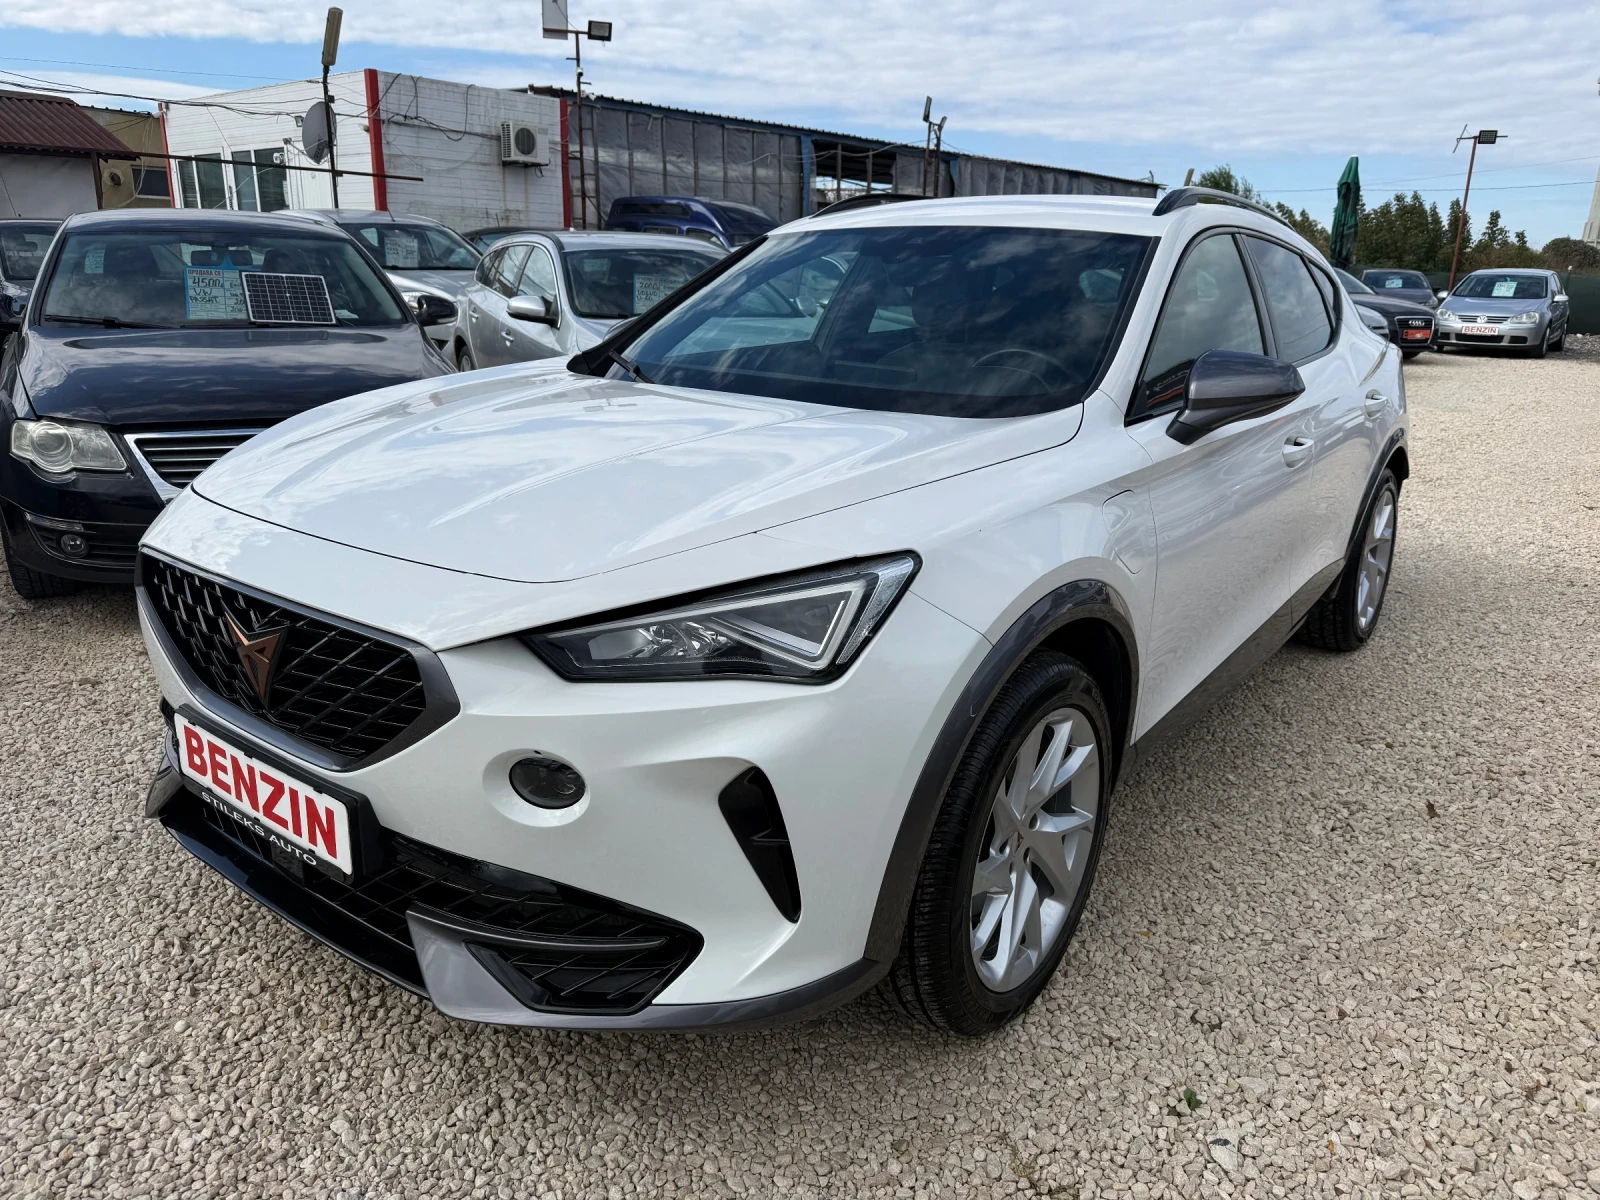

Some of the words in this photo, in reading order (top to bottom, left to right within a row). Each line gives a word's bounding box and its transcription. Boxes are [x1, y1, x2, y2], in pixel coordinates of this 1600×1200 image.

[193, 287, 213, 296] VW
[1464, 326, 1496, 334] BENZIN
[183, 724, 338, 860] BENZIN
[201, 791, 265, 837] STILEKS
[269, 834, 317, 866] AUTO
